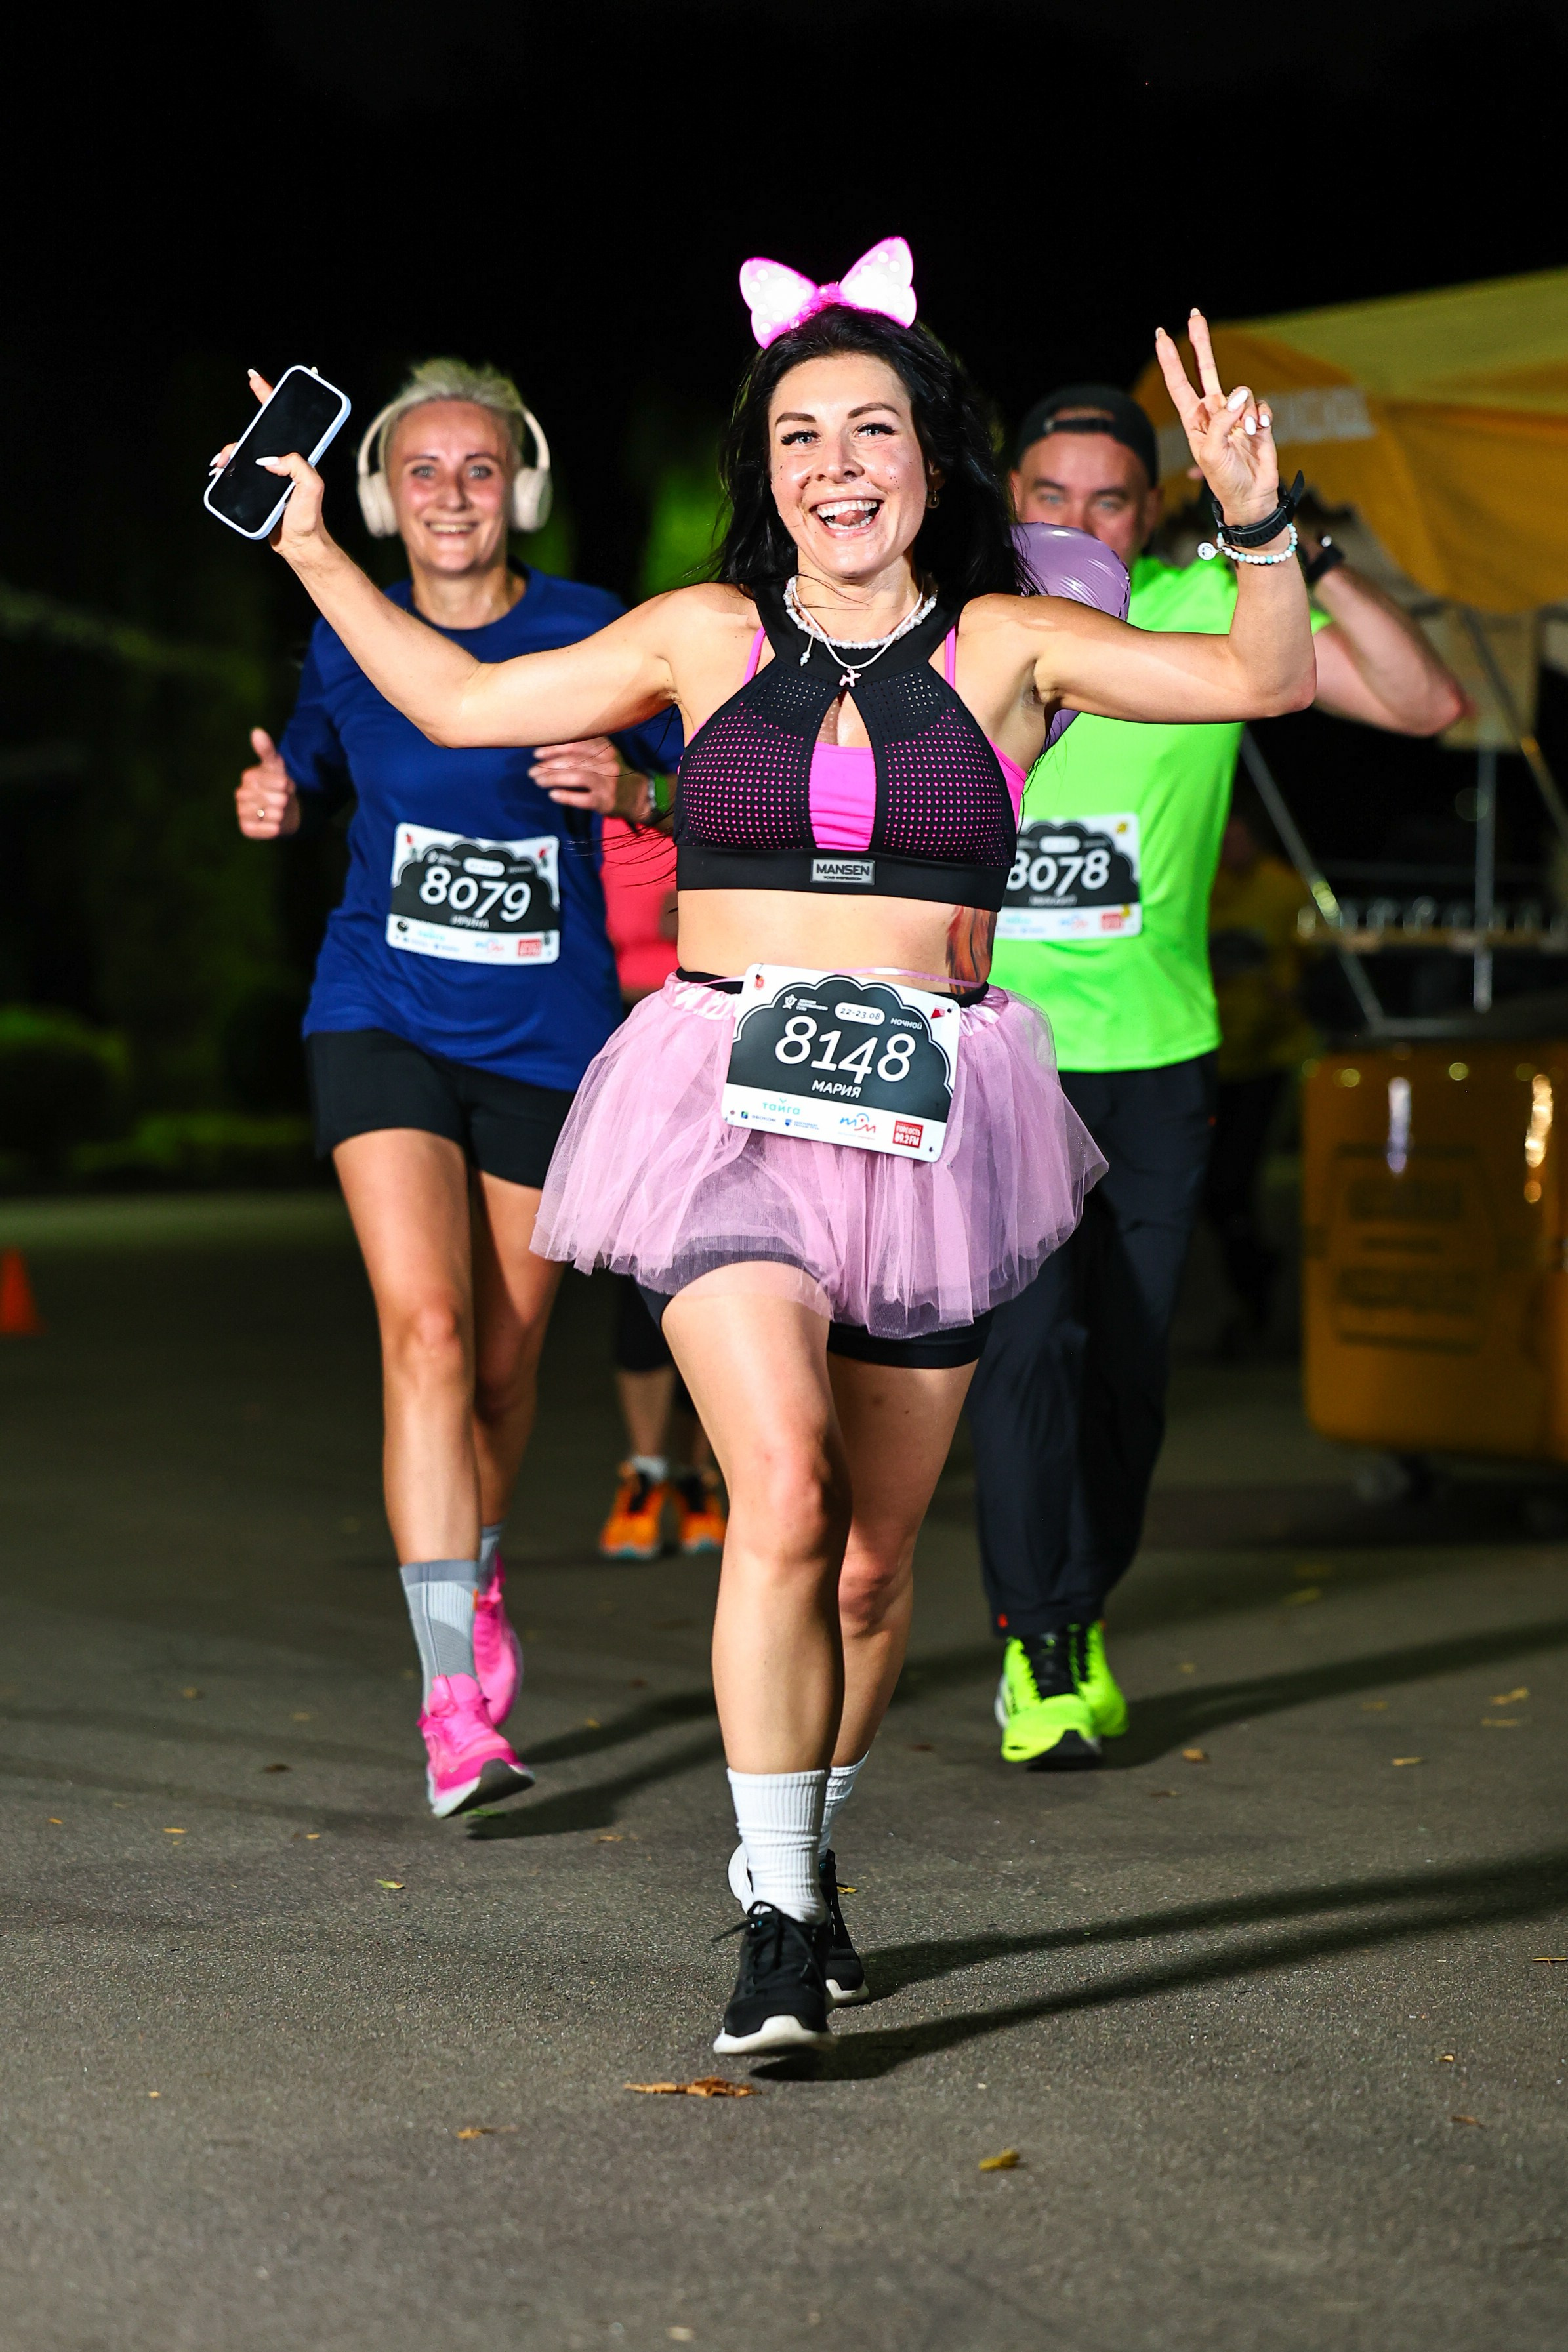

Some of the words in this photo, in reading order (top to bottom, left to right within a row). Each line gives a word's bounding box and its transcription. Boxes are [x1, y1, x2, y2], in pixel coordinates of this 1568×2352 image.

[816, 863, 869, 876] MANSEN
[1006, 848, 1111, 897] 8078
[419, 865, 531, 923] 8079
[840, 1008, 881, 1020] 22-23.08
[890, 1018, 923, 1030] НОЧНОЙ
[775, 1015, 917, 1084] 8148
[811, 1079, 863, 1099] МАРИЯ
[909, 1135, 920, 1146] FM
